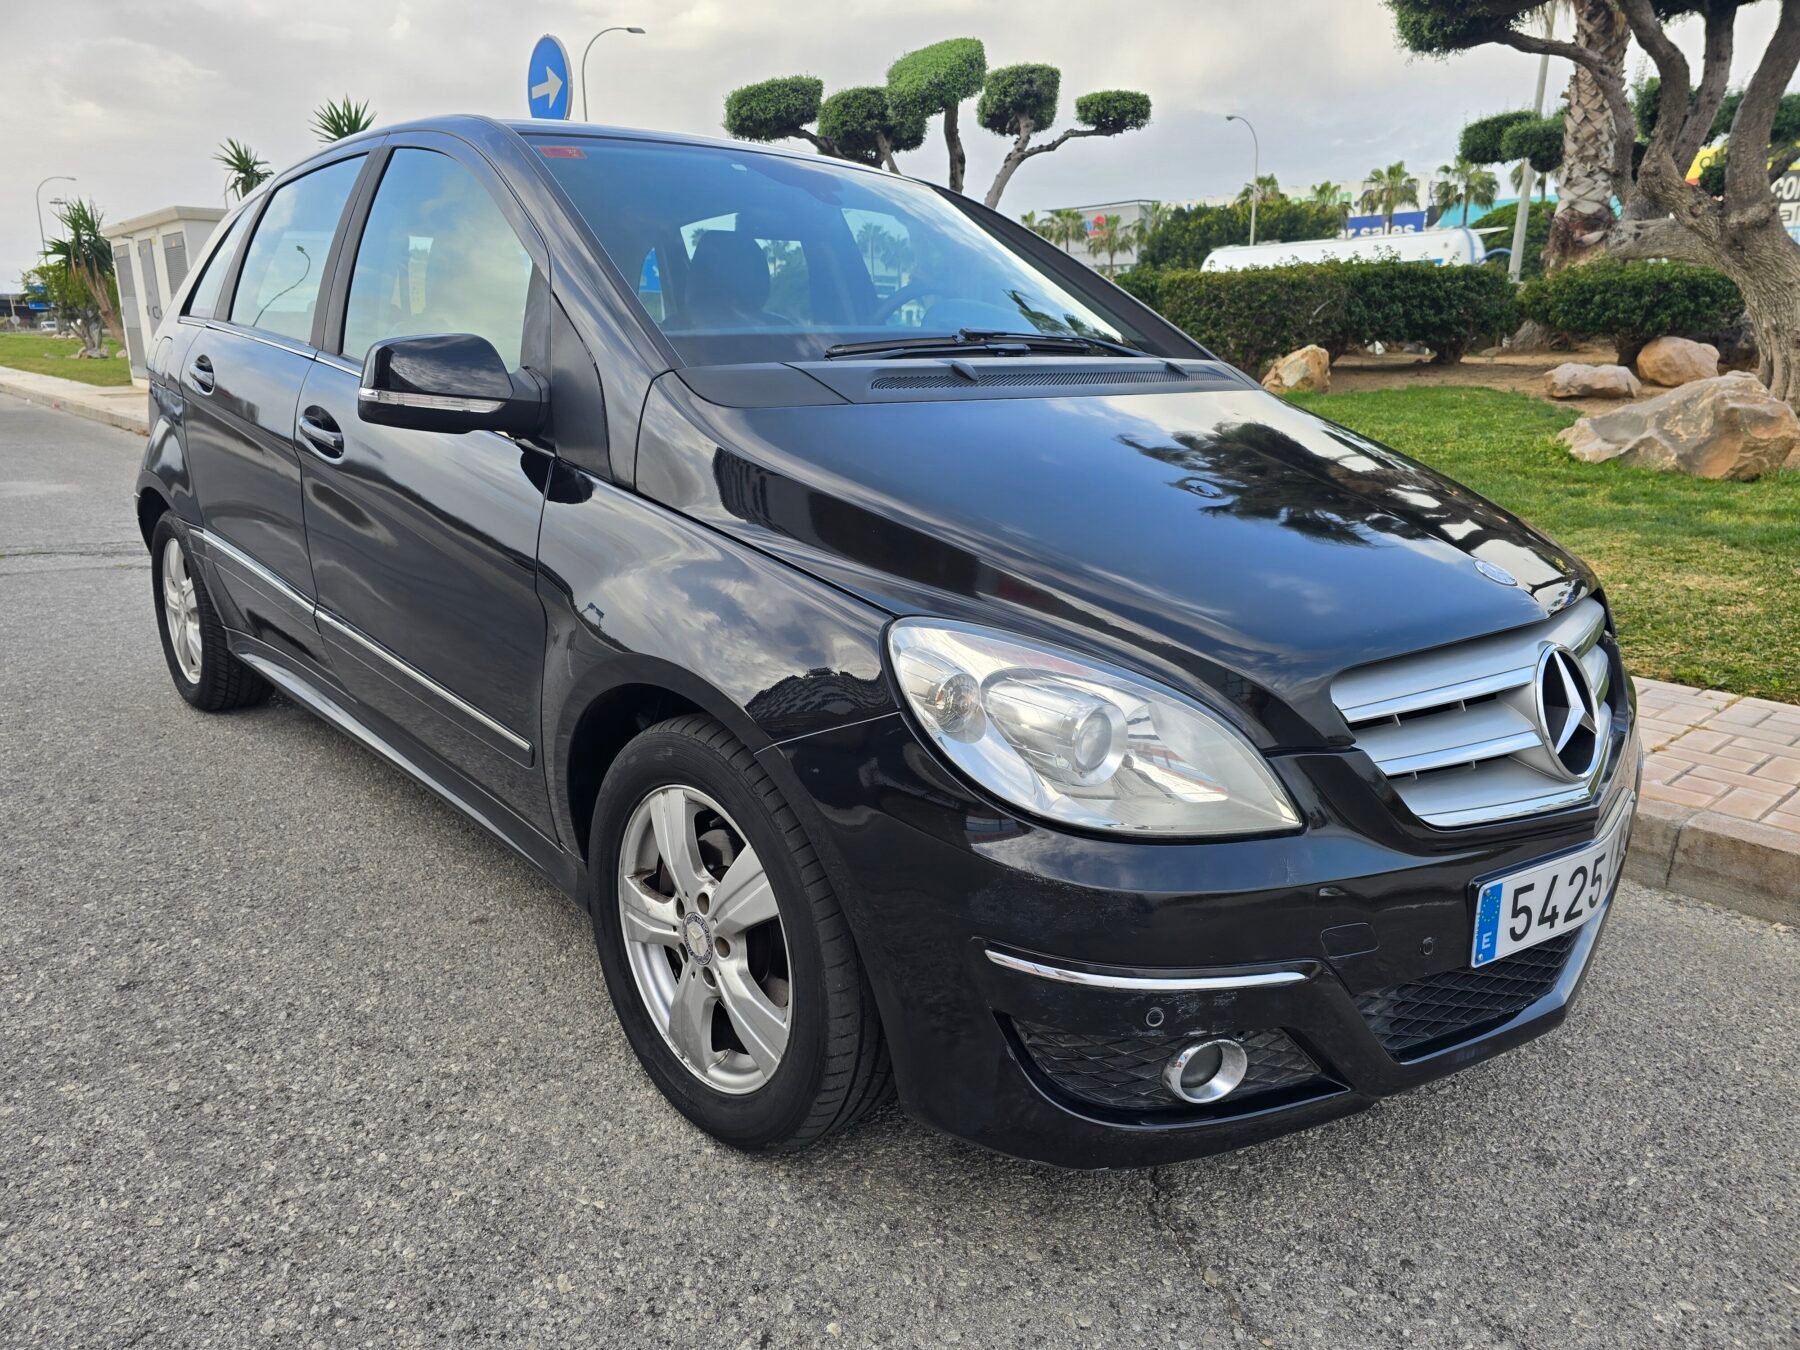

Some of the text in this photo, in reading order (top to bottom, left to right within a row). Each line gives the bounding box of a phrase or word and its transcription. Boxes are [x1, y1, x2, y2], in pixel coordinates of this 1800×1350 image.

[1336, 221, 1416, 240] ar sales
[1481, 852, 1607, 950] E 5425
